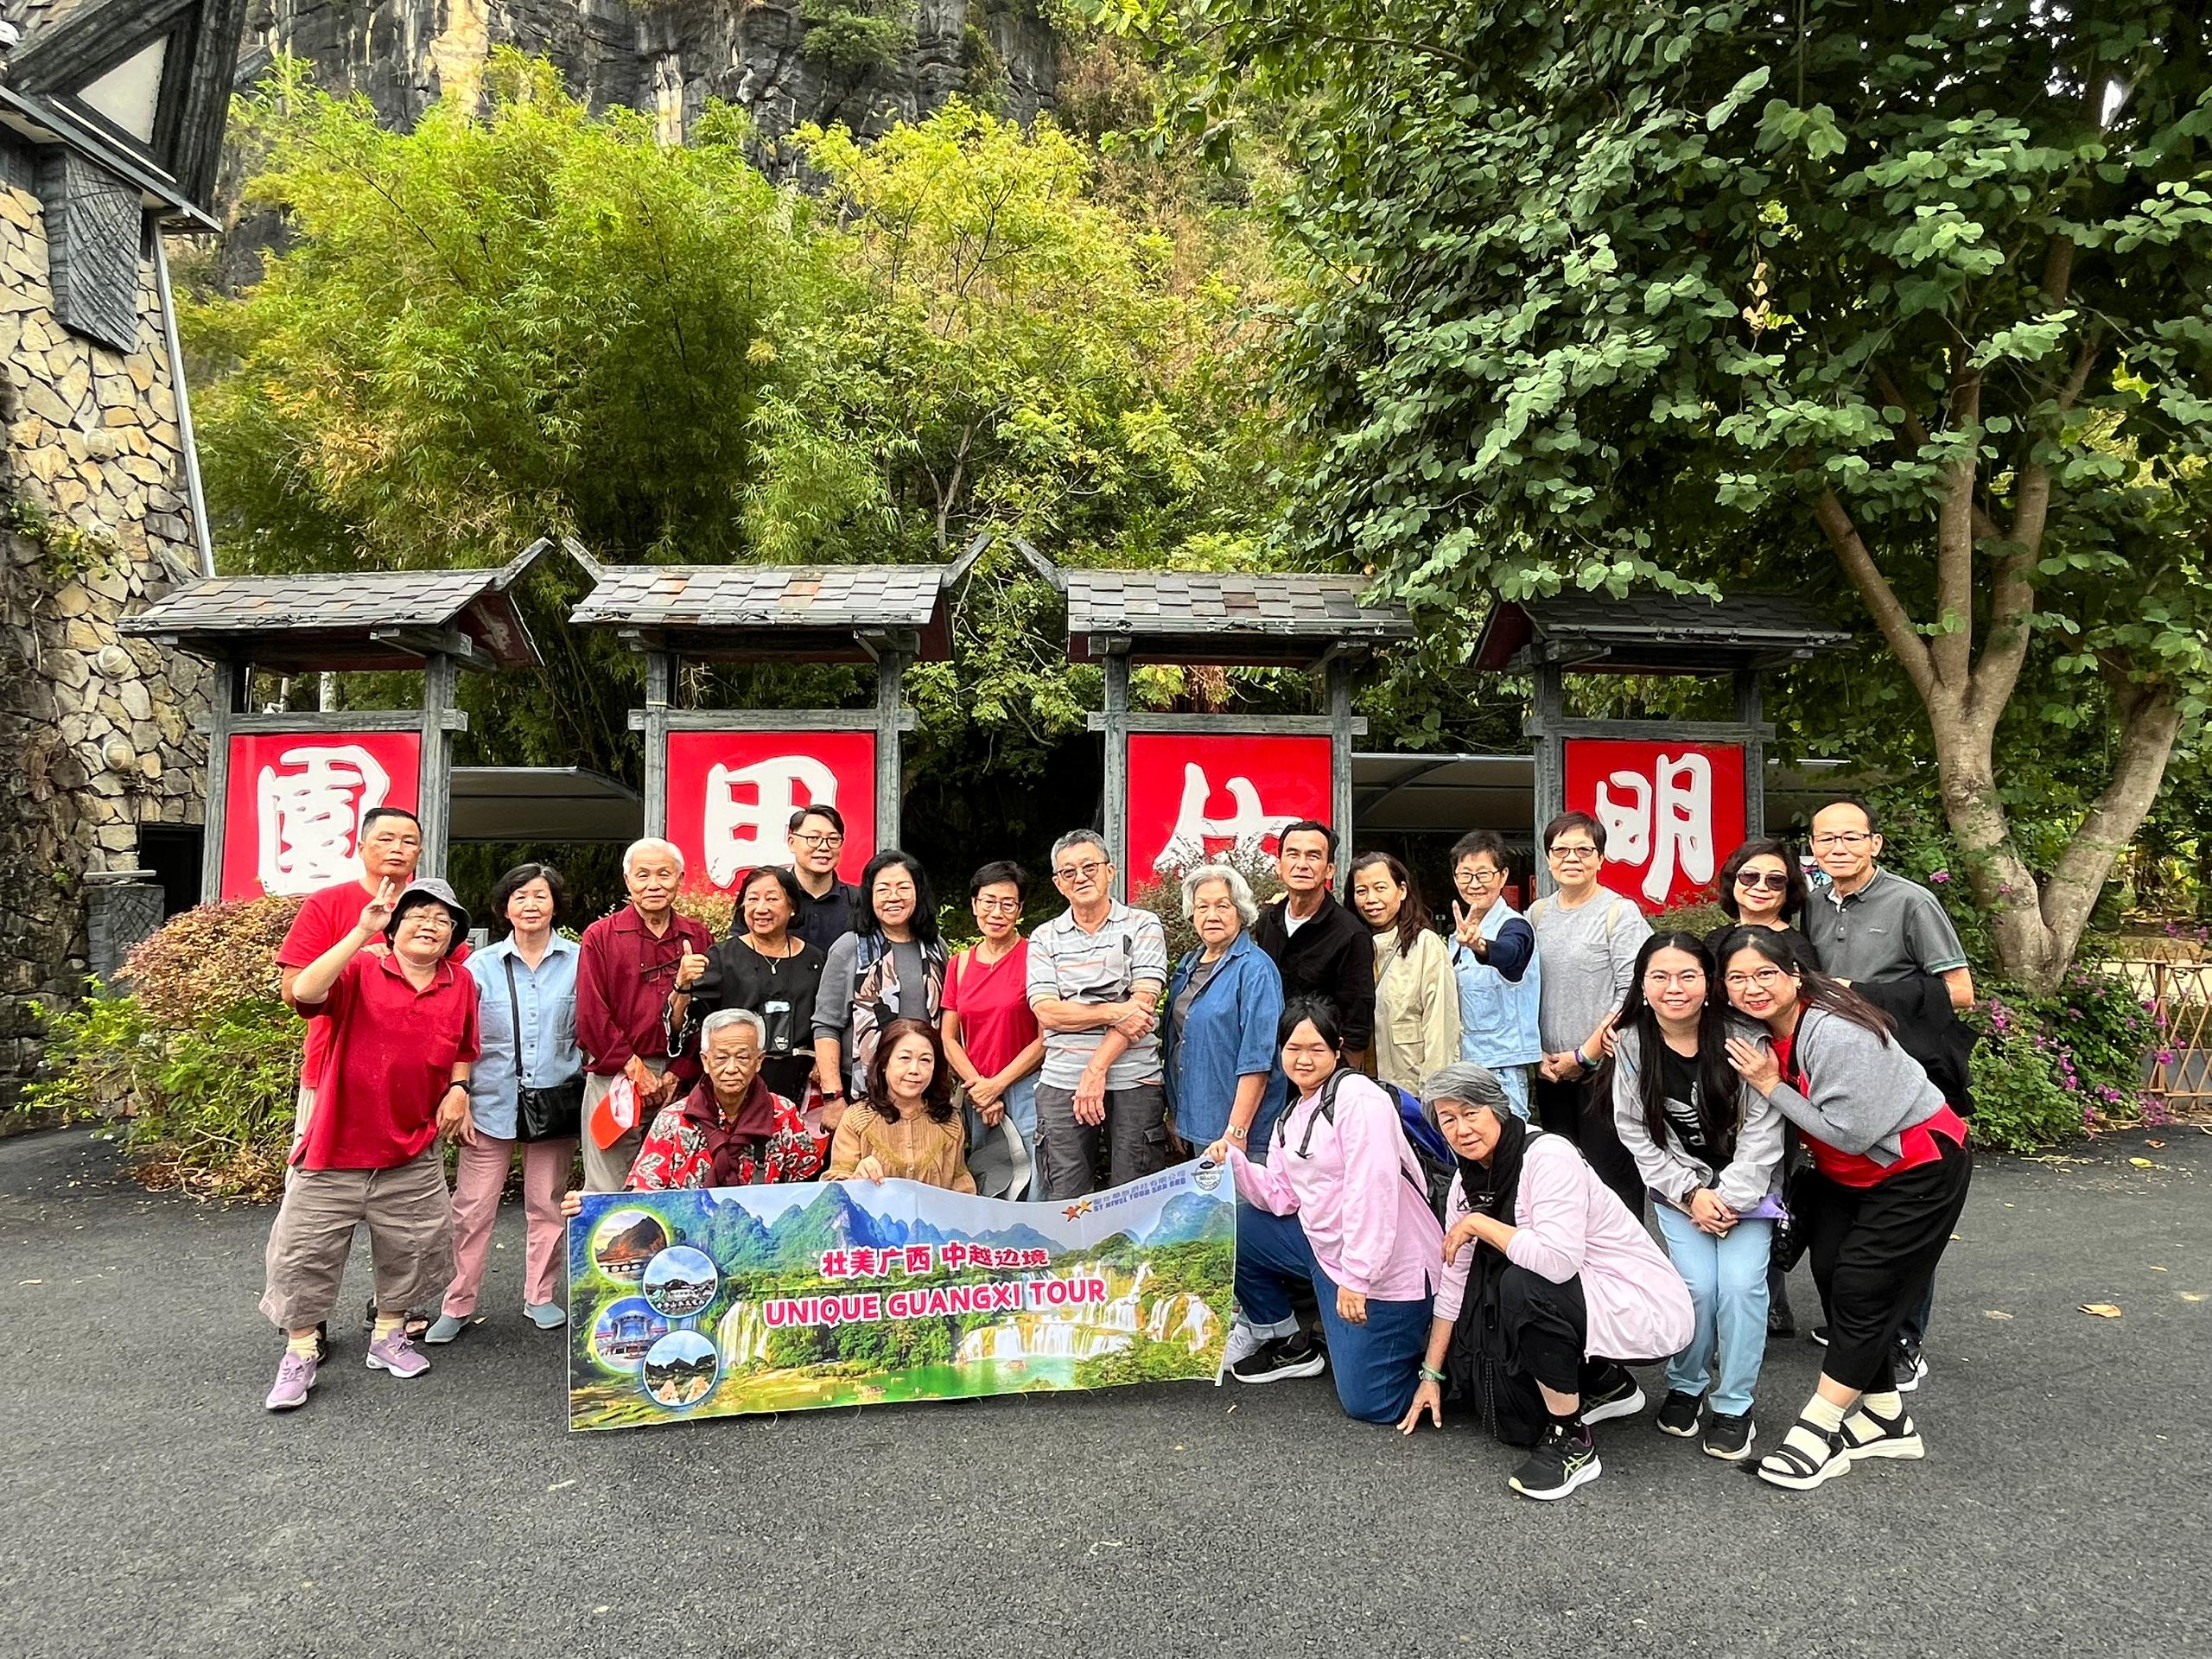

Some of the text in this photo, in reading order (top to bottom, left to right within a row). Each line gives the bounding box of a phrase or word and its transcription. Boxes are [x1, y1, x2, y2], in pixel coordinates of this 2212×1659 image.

[703, 754, 838, 889] 田
[1595, 753, 1715, 905] 明
[1129, 1189, 1150, 1200] TOUR
[823, 1243, 1050, 1277] 壮美广西 中越边境
[766, 1279, 1106, 1325] UNIQUE GUANGXI TOUR
